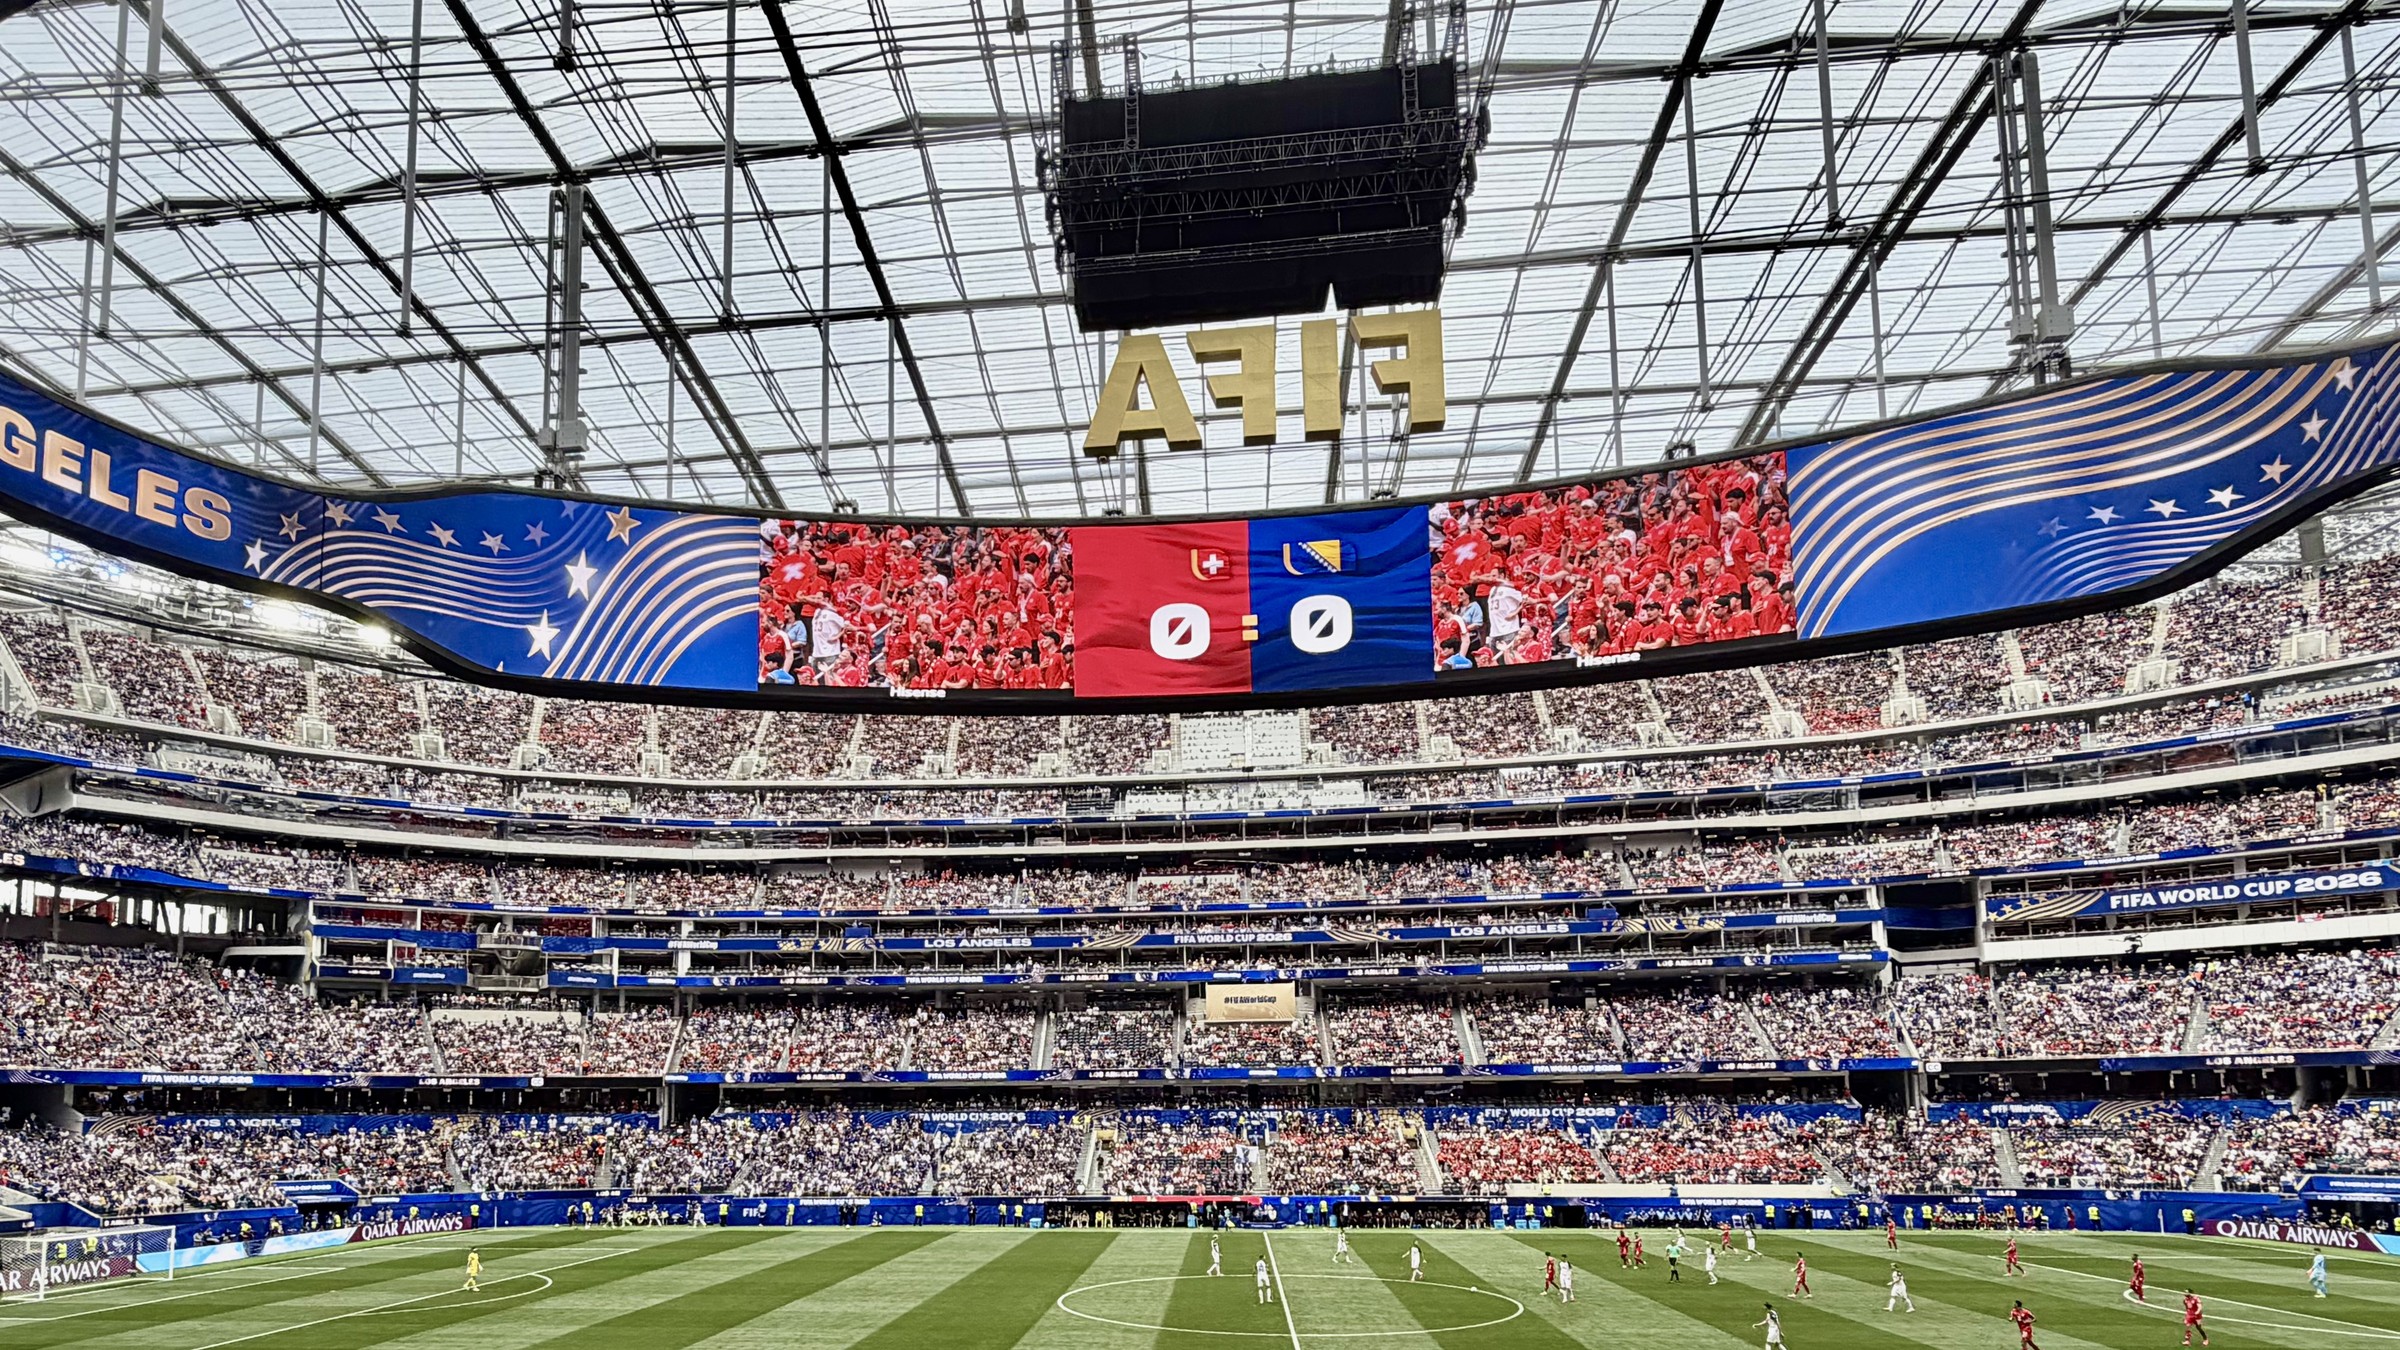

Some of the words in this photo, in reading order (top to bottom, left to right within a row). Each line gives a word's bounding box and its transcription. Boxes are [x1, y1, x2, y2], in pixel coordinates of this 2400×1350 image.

[1577, 652, 1640, 667] Hisense
[890, 686, 946, 698] Hisense
[0, 853, 25, 867] ES
[2110, 892, 2157, 909] FIFA
[2158, 885, 2240, 904] WORLD
[2243, 880, 2291, 897] CUP
[2294, 871, 2383, 893] 2026
[1450, 927, 1485, 937] LOS
[1488, 924, 1570, 935] ANGELES
[924, 939, 956, 948] LOS
[958, 938, 1032, 947] ANGELES
[1174, 934, 1196, 944] FIFA
[1196, 934, 1234, 943] WORLD
[1234, 933, 1255, 942] CUP
[1256, 933, 1293, 942] 2026
[931, 1112, 968, 1121] WORLD
[1210, 1111, 1238, 1119] OS
[1485, 1108, 1508, 1117] FIF
[1510, 1108, 1550, 1117] WORLD
[1552, 1108, 1575, 1117] CUP
[1576, 1108, 1616, 1116] 2026
[743, 1208, 760, 1217] FIF
[1811, 1209, 1833, 1219] IFA
[362, 1223, 399, 1241] QATAR
[402, 1216, 463, 1236] AIRWAYS
[2216, 1220, 2281, 1241] QATAR
[2286, 1227, 2360, 1249] AIRWAYS
